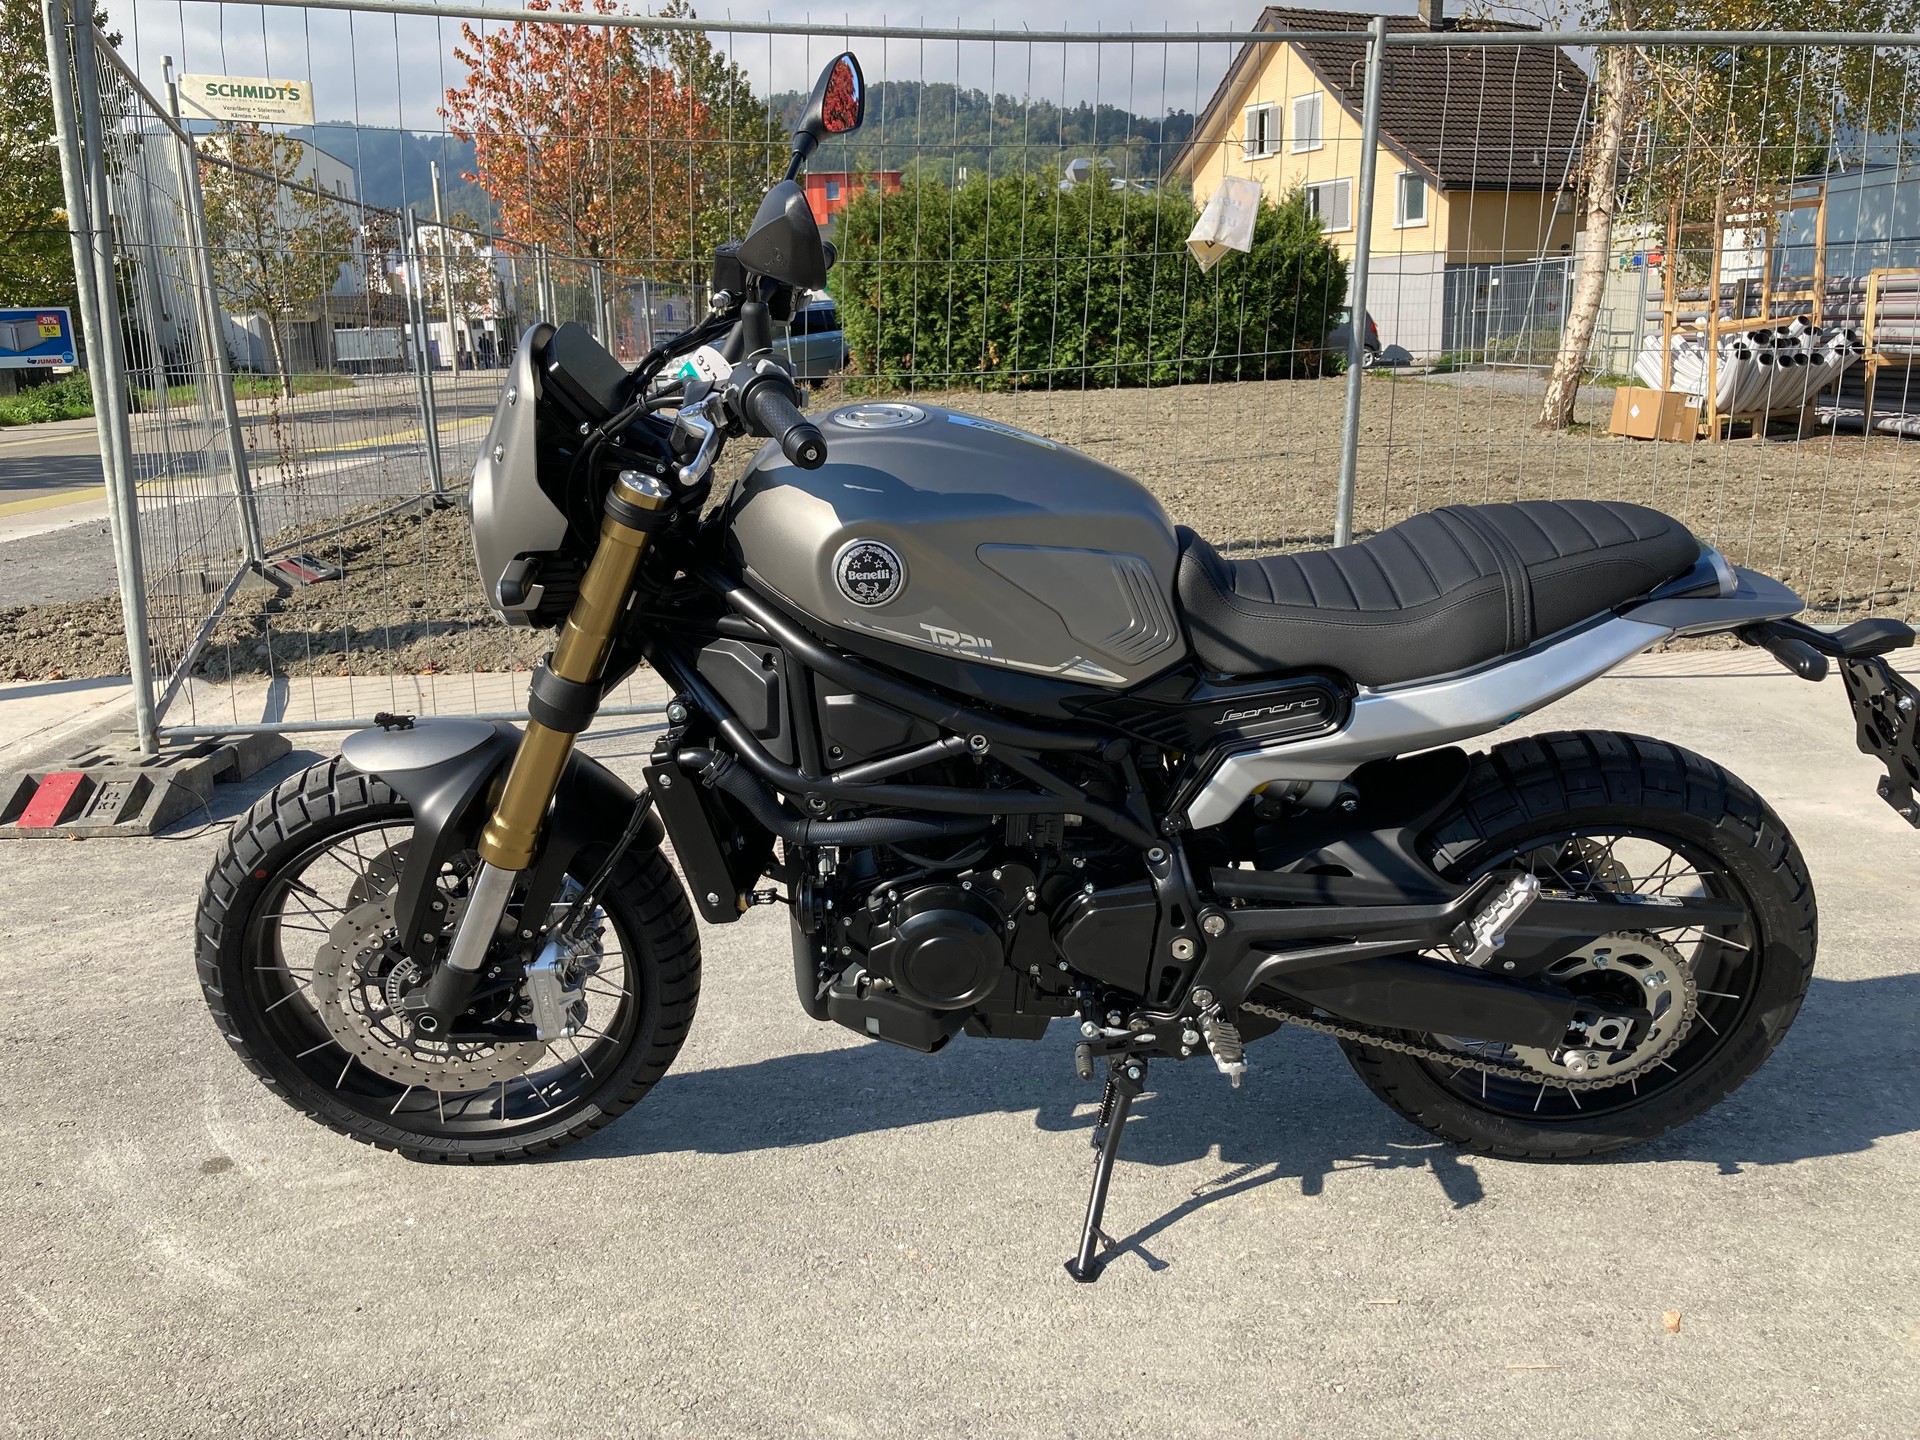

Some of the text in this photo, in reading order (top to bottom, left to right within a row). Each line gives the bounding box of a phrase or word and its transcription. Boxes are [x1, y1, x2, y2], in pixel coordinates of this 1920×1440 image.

[205, 82, 301, 101] SCHMIDT'S
[222, 104, 286, 114] Vorarlberg Steiermark
[40, 316, 57, 325] -51%
[847, 568, 891, 581] Benelli
